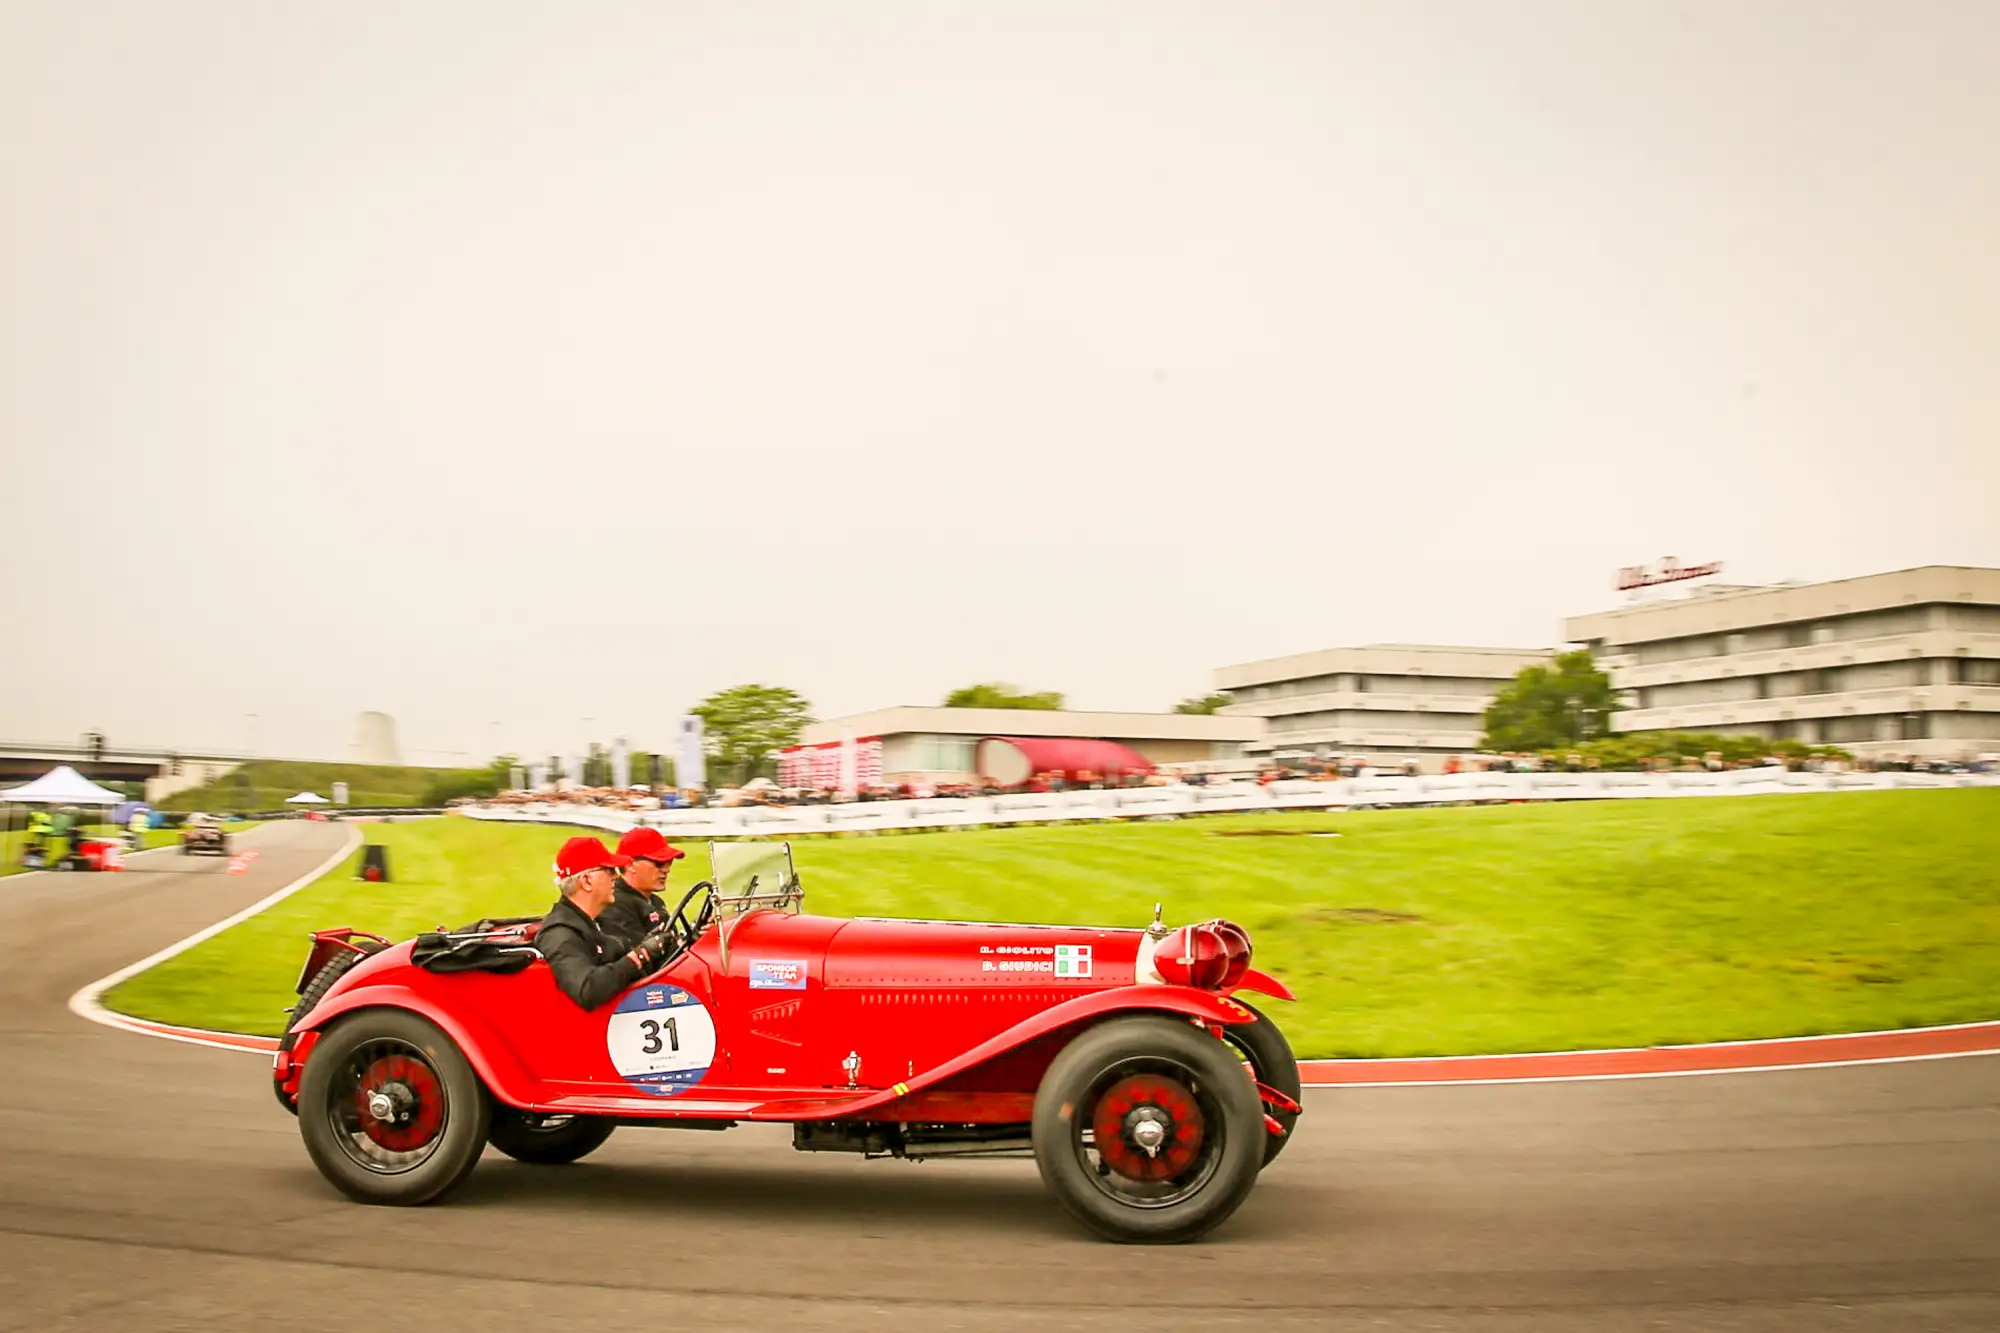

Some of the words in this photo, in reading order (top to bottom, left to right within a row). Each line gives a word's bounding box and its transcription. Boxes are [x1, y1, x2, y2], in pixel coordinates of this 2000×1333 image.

[756, 964, 797, 973] SPONSOR
[982, 961, 997, 971] D.
[999, 961, 1053, 971] GIUDICI
[773, 971, 797, 980] TEAM
[640, 1017, 679, 1054] 31
